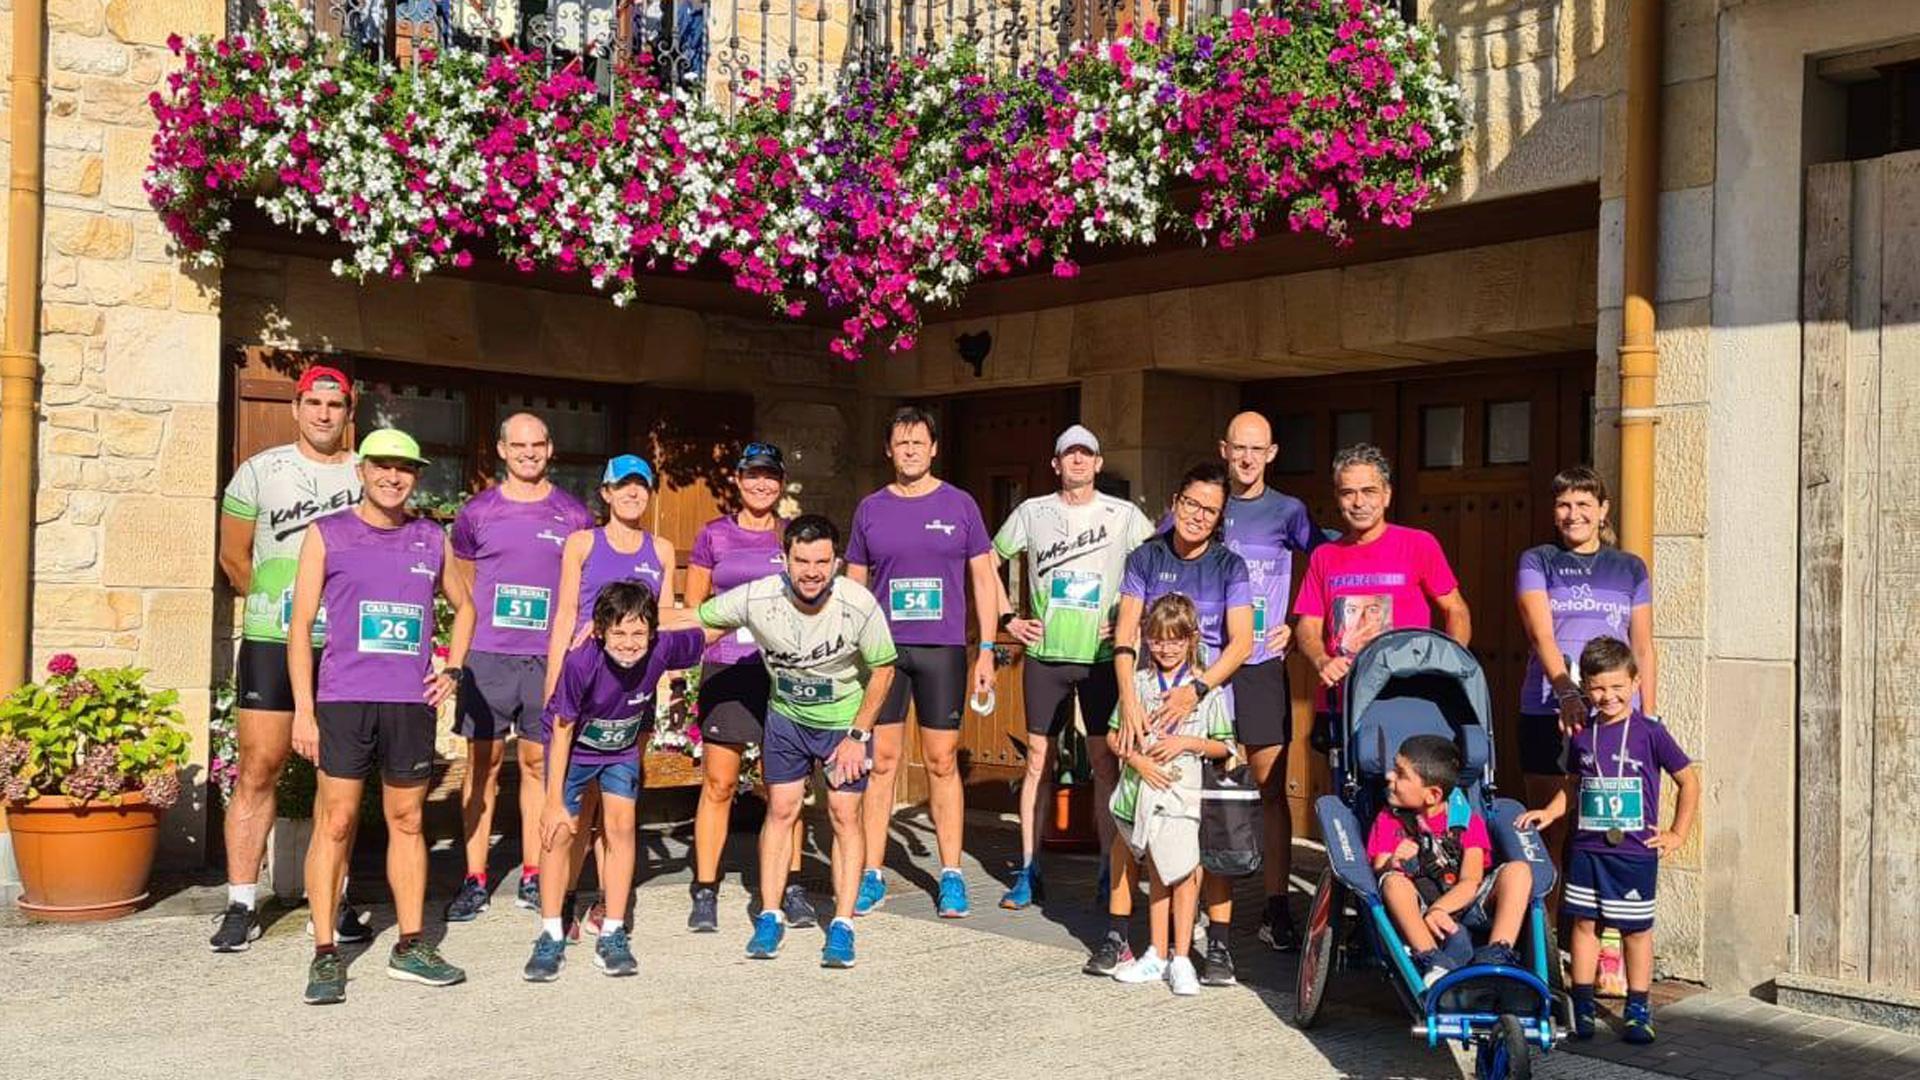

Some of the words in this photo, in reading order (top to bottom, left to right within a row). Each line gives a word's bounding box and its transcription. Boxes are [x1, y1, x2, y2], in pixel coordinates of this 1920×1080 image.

[509, 599, 532, 617] 51
[904, 592, 928, 609] 54
[379, 618, 408, 640] 26
[791, 684, 817, 697] 50
[600, 729, 626, 742] 56
[1593, 795, 1623, 816] 19
